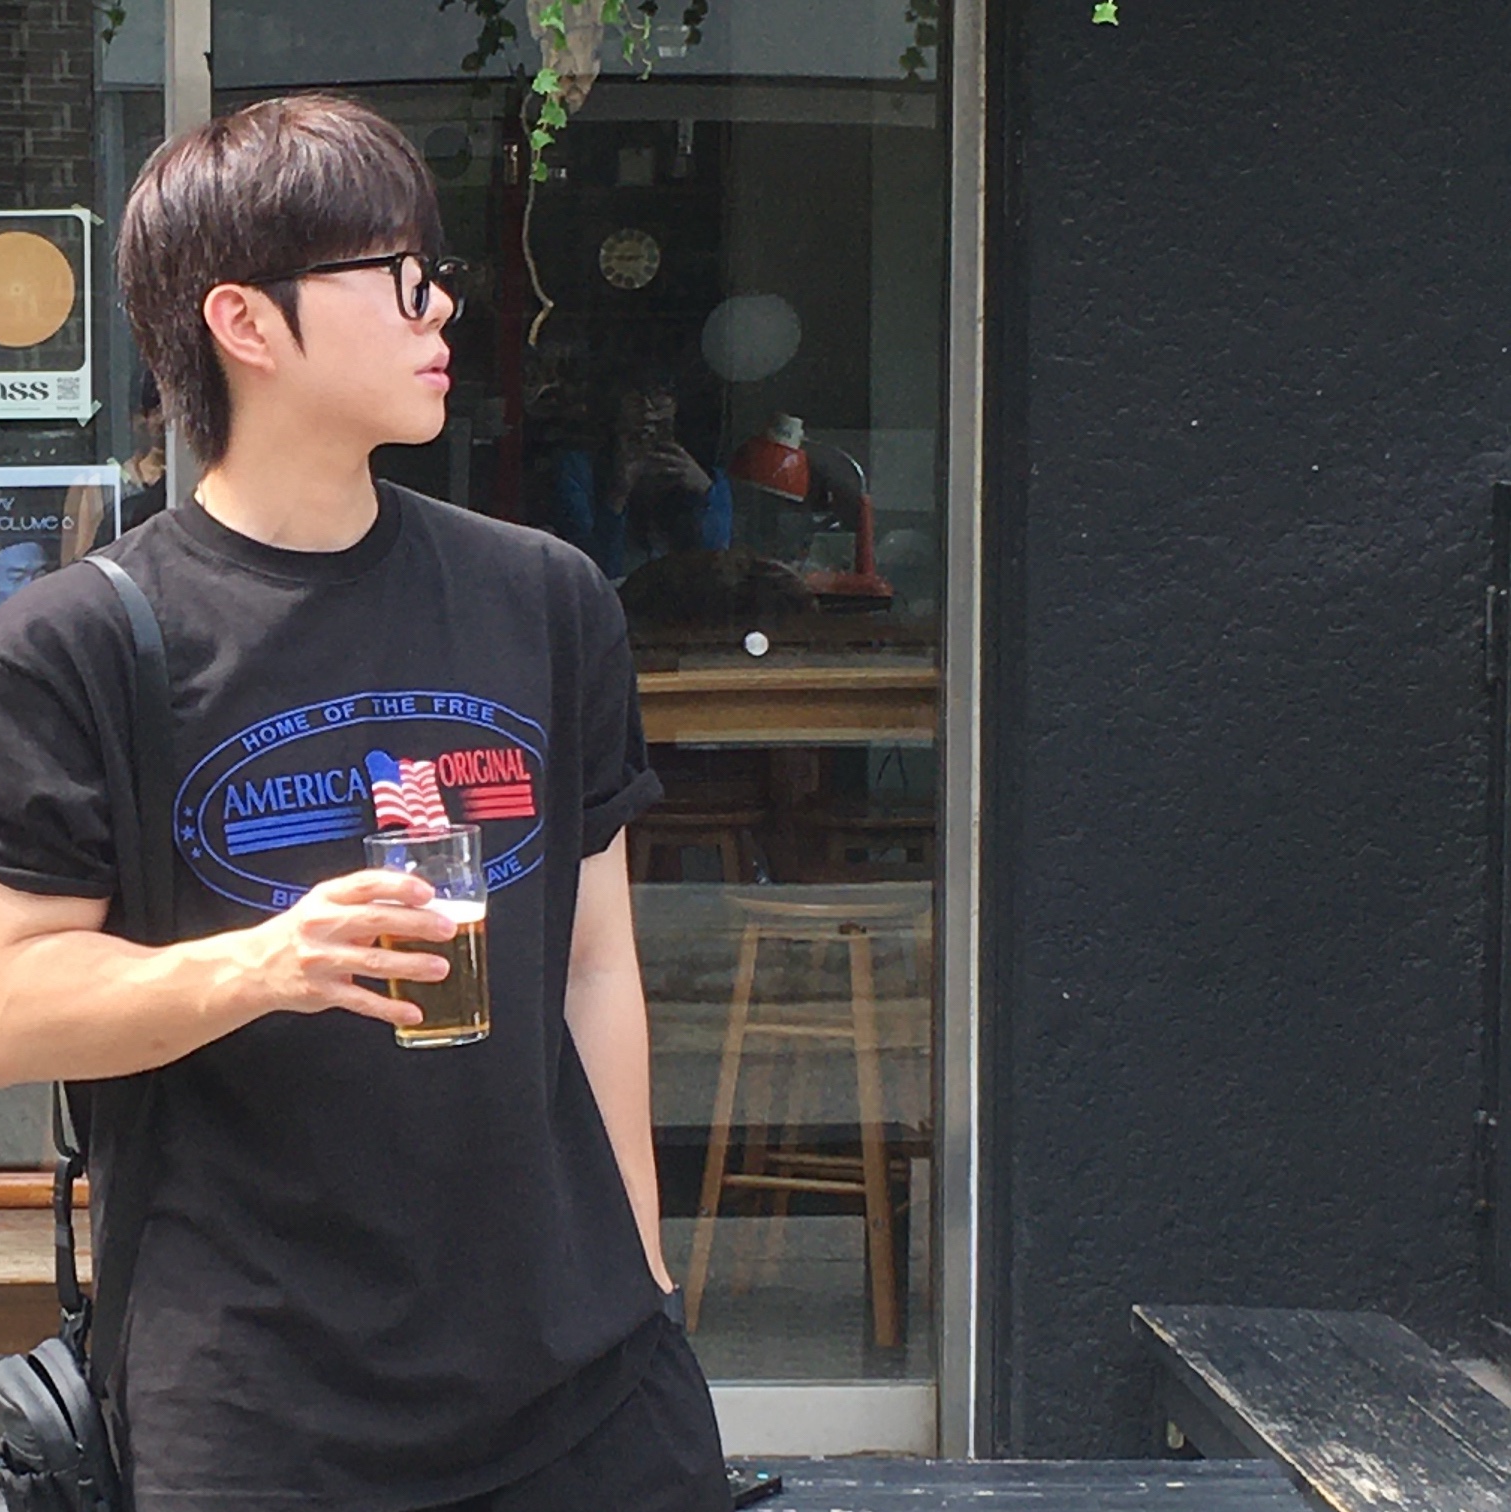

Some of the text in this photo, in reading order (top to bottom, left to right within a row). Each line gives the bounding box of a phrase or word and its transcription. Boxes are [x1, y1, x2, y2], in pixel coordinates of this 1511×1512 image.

[242, 697, 495, 752] HOME OF THE FREE
[223, 748, 531, 819] AMERICA ORIGINAL
